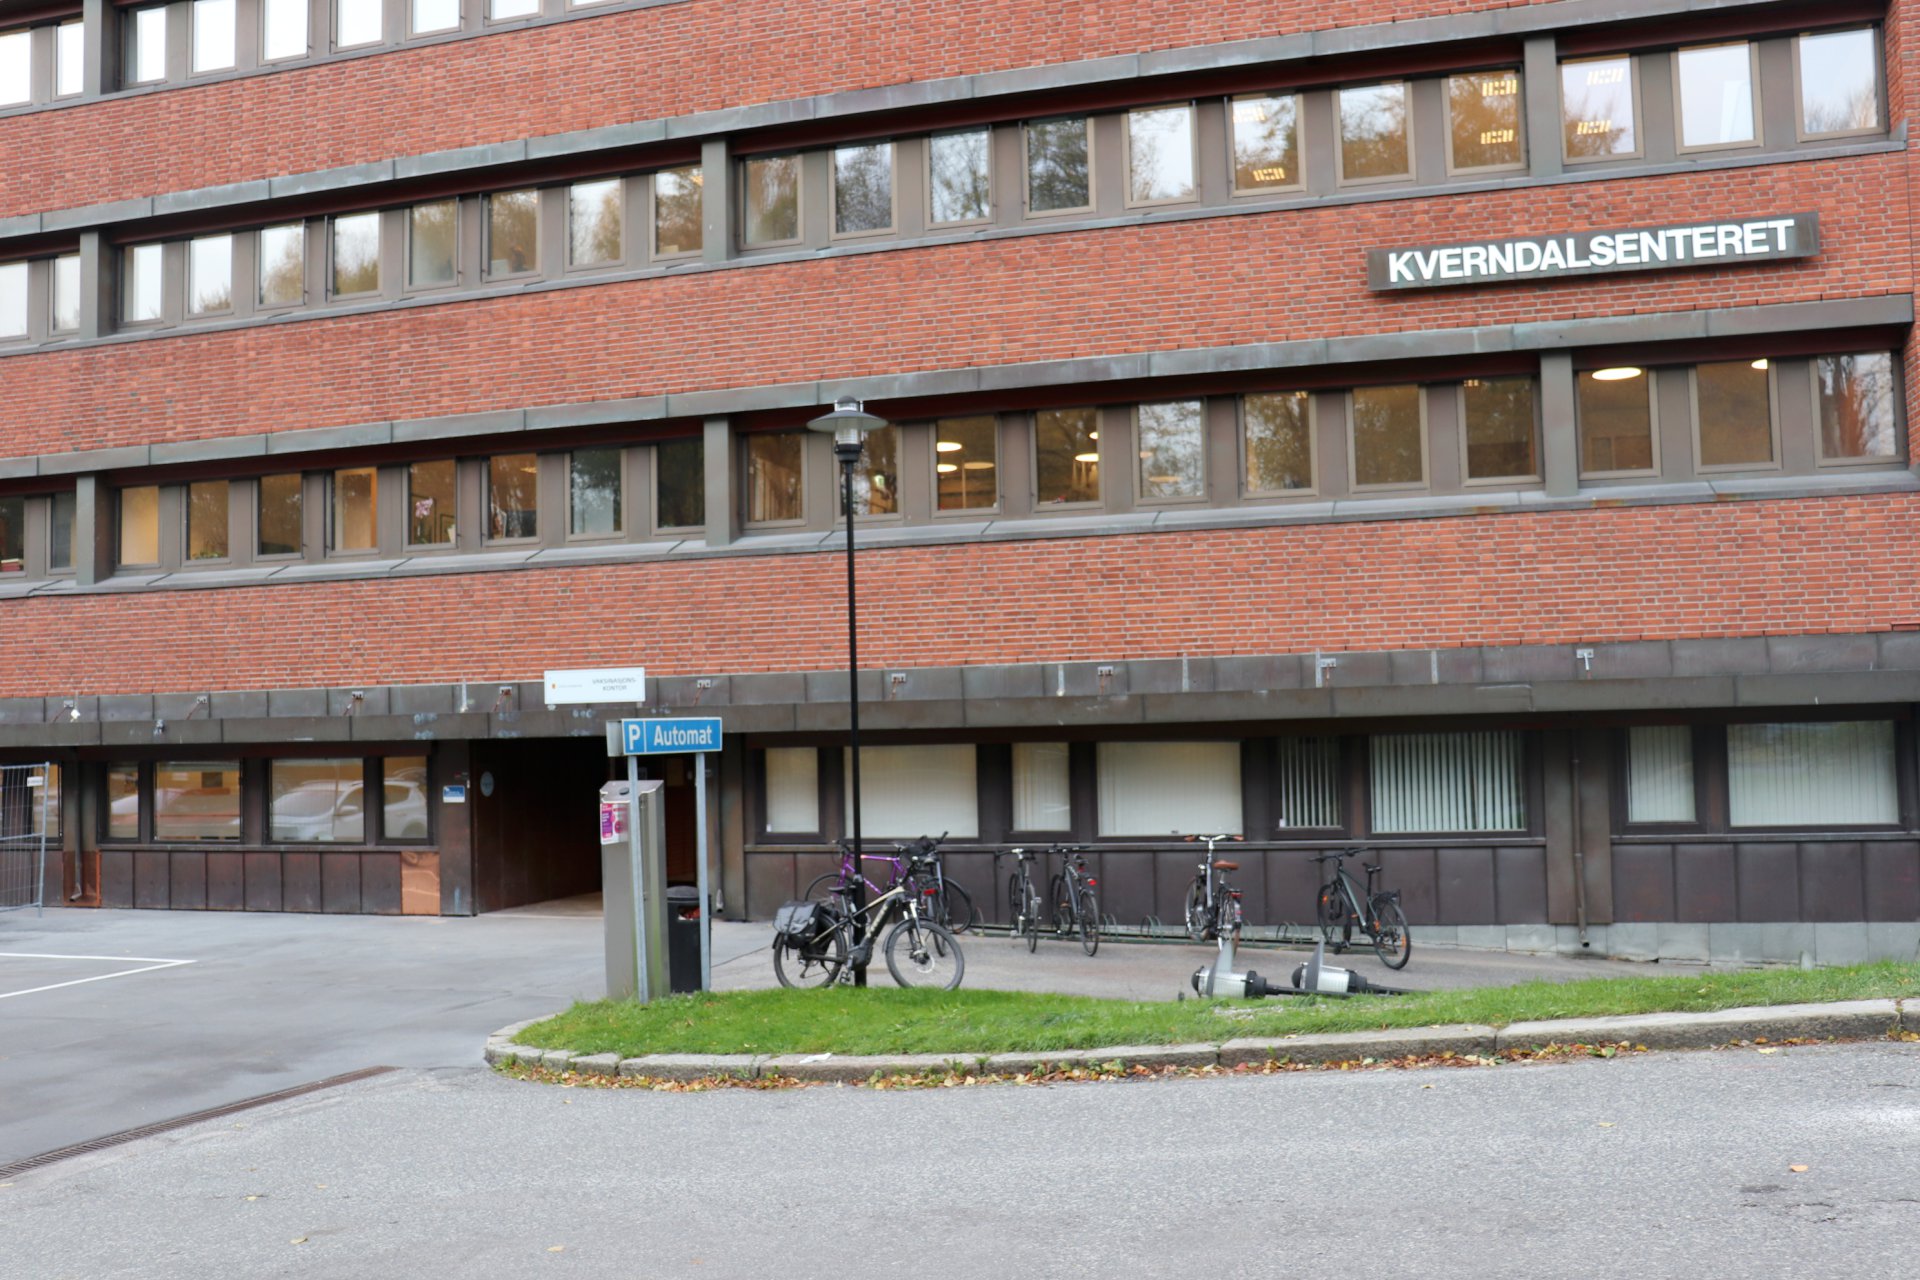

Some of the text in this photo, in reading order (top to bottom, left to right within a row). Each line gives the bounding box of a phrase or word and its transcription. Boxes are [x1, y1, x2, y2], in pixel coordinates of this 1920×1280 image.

[1388, 219, 1795, 283] KVERNDALSENTERET
[628, 724, 713, 750] P Automat
